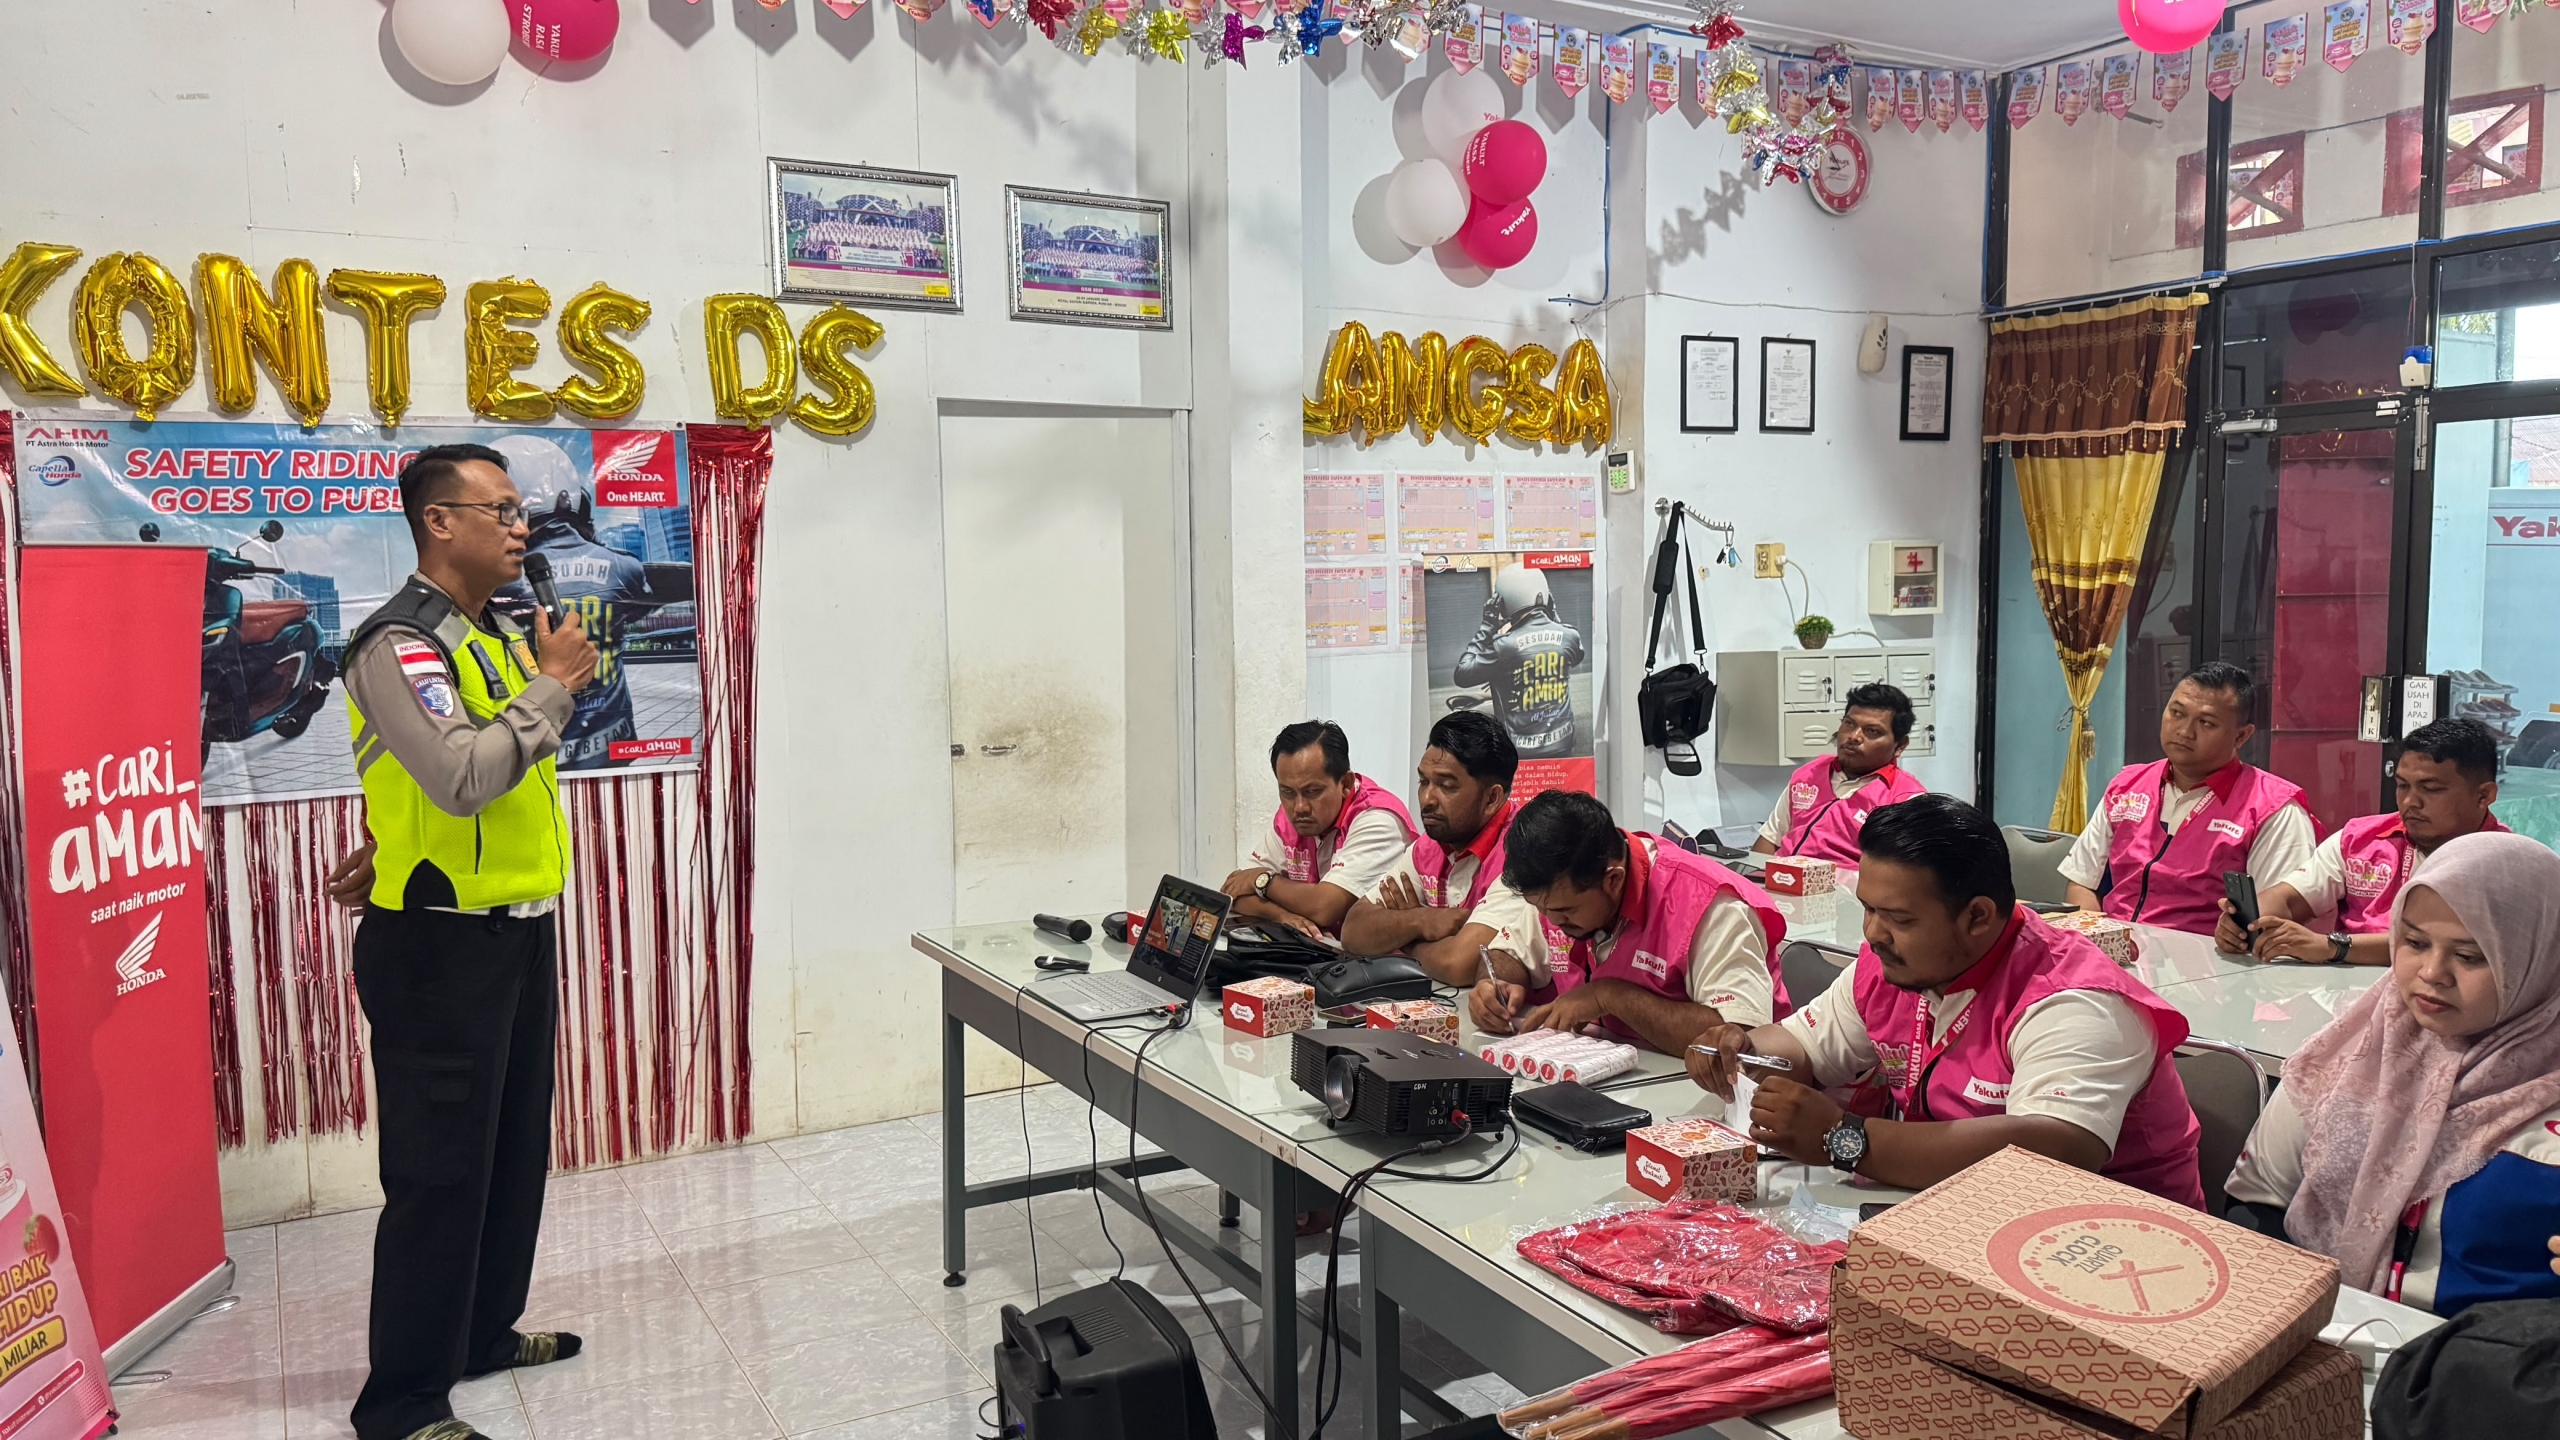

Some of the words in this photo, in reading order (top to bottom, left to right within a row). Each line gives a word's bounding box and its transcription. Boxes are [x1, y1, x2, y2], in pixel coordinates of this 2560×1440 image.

[535, 23, 546, 50] RASA
[550, 23, 561, 59] YAKULT
[1483, 112, 1504, 123] Yak
[1836, 131, 1846, 141] 12
[1850, 138, 1855, 148] 1
[1471, 137, 1481, 163] RASA
[1479, 131, 1491, 167] YAKULT
[1857, 152, 1864, 161] 2
[1860, 169, 1865, 178] 3
[1821, 192, 1828, 200] 7
[1855, 186, 1861, 194] 4
[1832, 198, 1839, 208] 6
[1500, 206, 1531, 236] Yakult
[704, 294, 884, 435] DS
[26, 427, 110, 440] AHM
[37, 440, 58, 448] Astra
[59, 440, 84, 448] Honda
[28, 464, 68, 474] Capella
[126, 448, 283, 479] SAFETY
[45, 471, 82, 479] Honda
[607, 473, 664, 482] HONDA
[151, 487, 254, 514] GOES
[261, 487, 313, 514] TO
[607, 491, 628, 502] One
[629, 491, 666, 503] HEART.
[1518, 632, 1563, 648] SESUDAH
[1523, 651, 1565, 686] CARI
[415, 678, 430, 688] LALU
[2409, 682, 2428, 690] GAK
[2413, 701, 2422, 709] DI
[2407, 711, 2428, 719] APA2
[2412, 721, 2422, 729] IN
[2213, 821, 2240, 835] Yakult
[2402, 845, 2415, 877] STROBE
[90, 903, 117, 924] saat
[119, 891, 145, 914] naik
[147, 881, 186, 906] motor
[1636, 954, 1665, 974] Yakult
[116, 968, 167, 996] HONDA
[1710, 994, 1736, 1006] Yakult
[1803, 1009, 1817, 1029] Yakult
[1908, 1041, 1922, 1088] YAKULT
[2046, 1234, 2102, 1267] CLOCK
[2074, 1244, 2124, 1274] QUARTZ
[11, 1252, 50, 1291] BAIK
[3, 1330, 49, 1372] MILIAR
